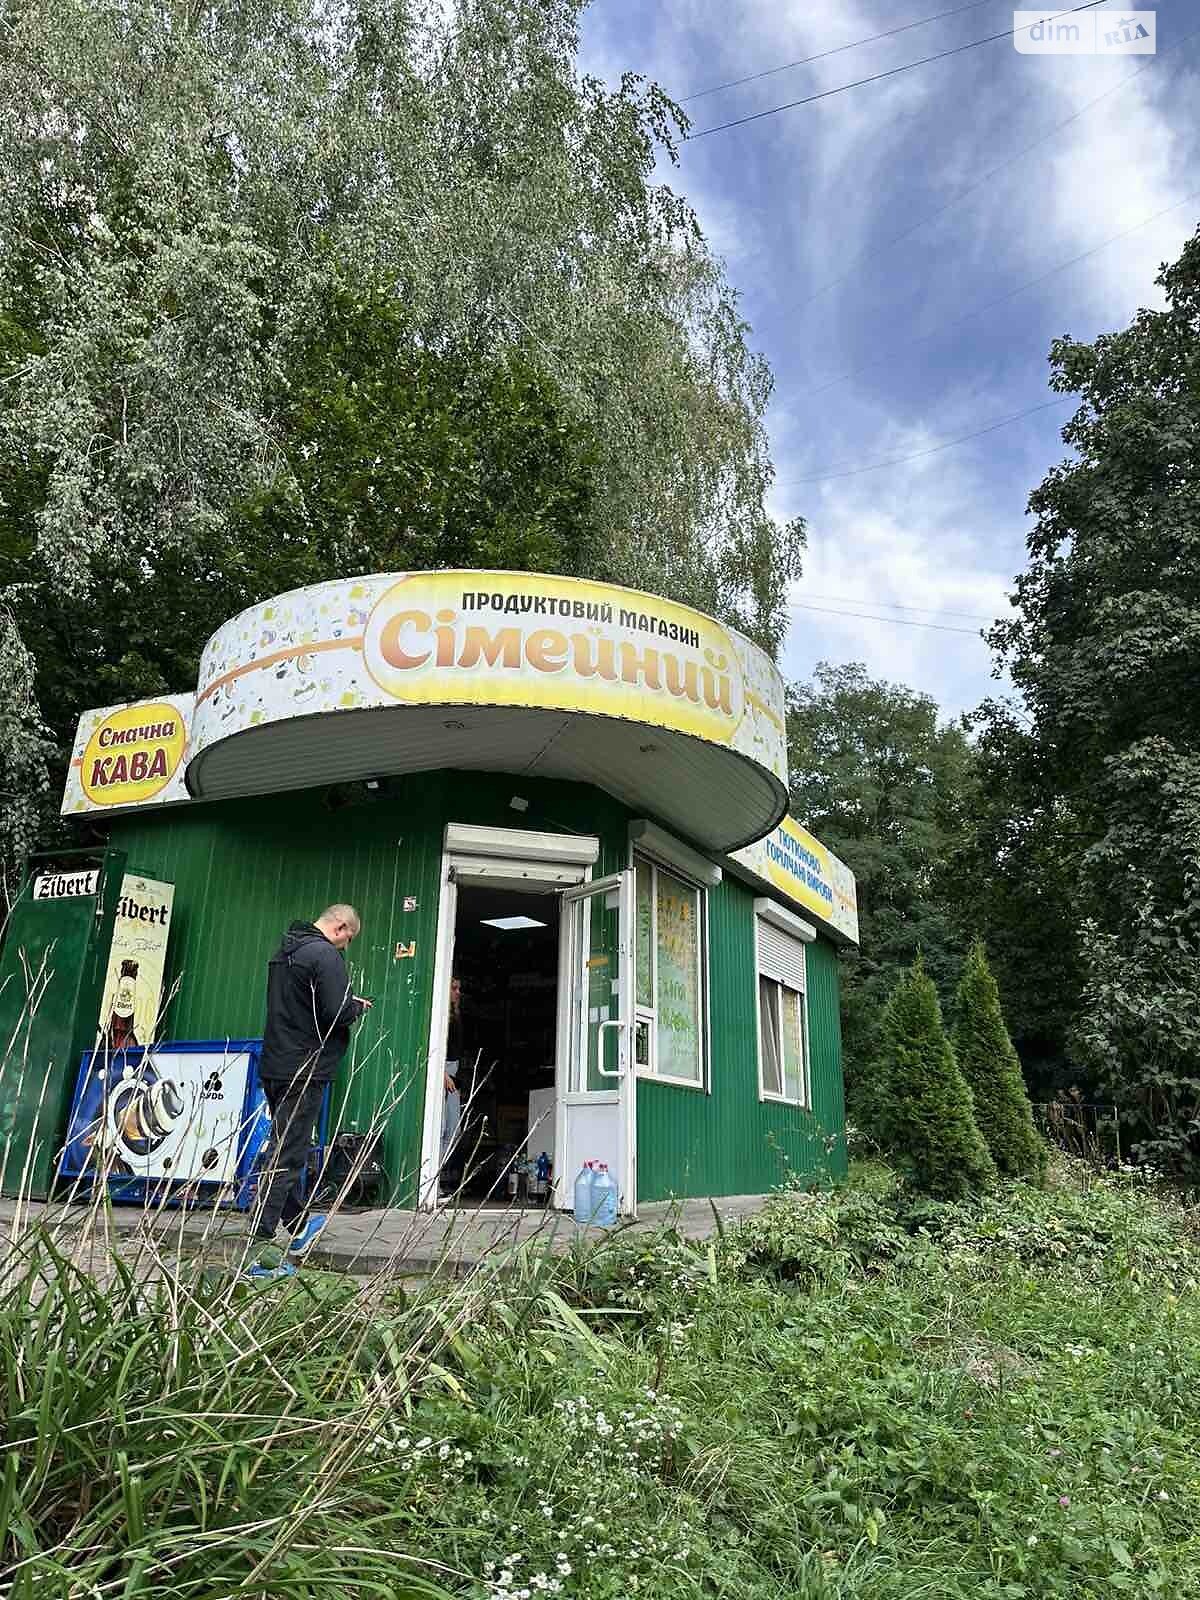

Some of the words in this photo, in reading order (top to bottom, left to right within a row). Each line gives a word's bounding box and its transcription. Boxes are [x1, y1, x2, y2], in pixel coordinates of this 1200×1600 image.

[462, 592, 613, 624] ПРОДУКТОВИЙ
[619, 609, 700, 649] МАГАЗИН
[380, 609, 733, 716] Сімейний
[98, 720, 175, 748] Смачна
[90, 748, 168, 788] КАВА
[37, 871, 95, 899] Zibert
